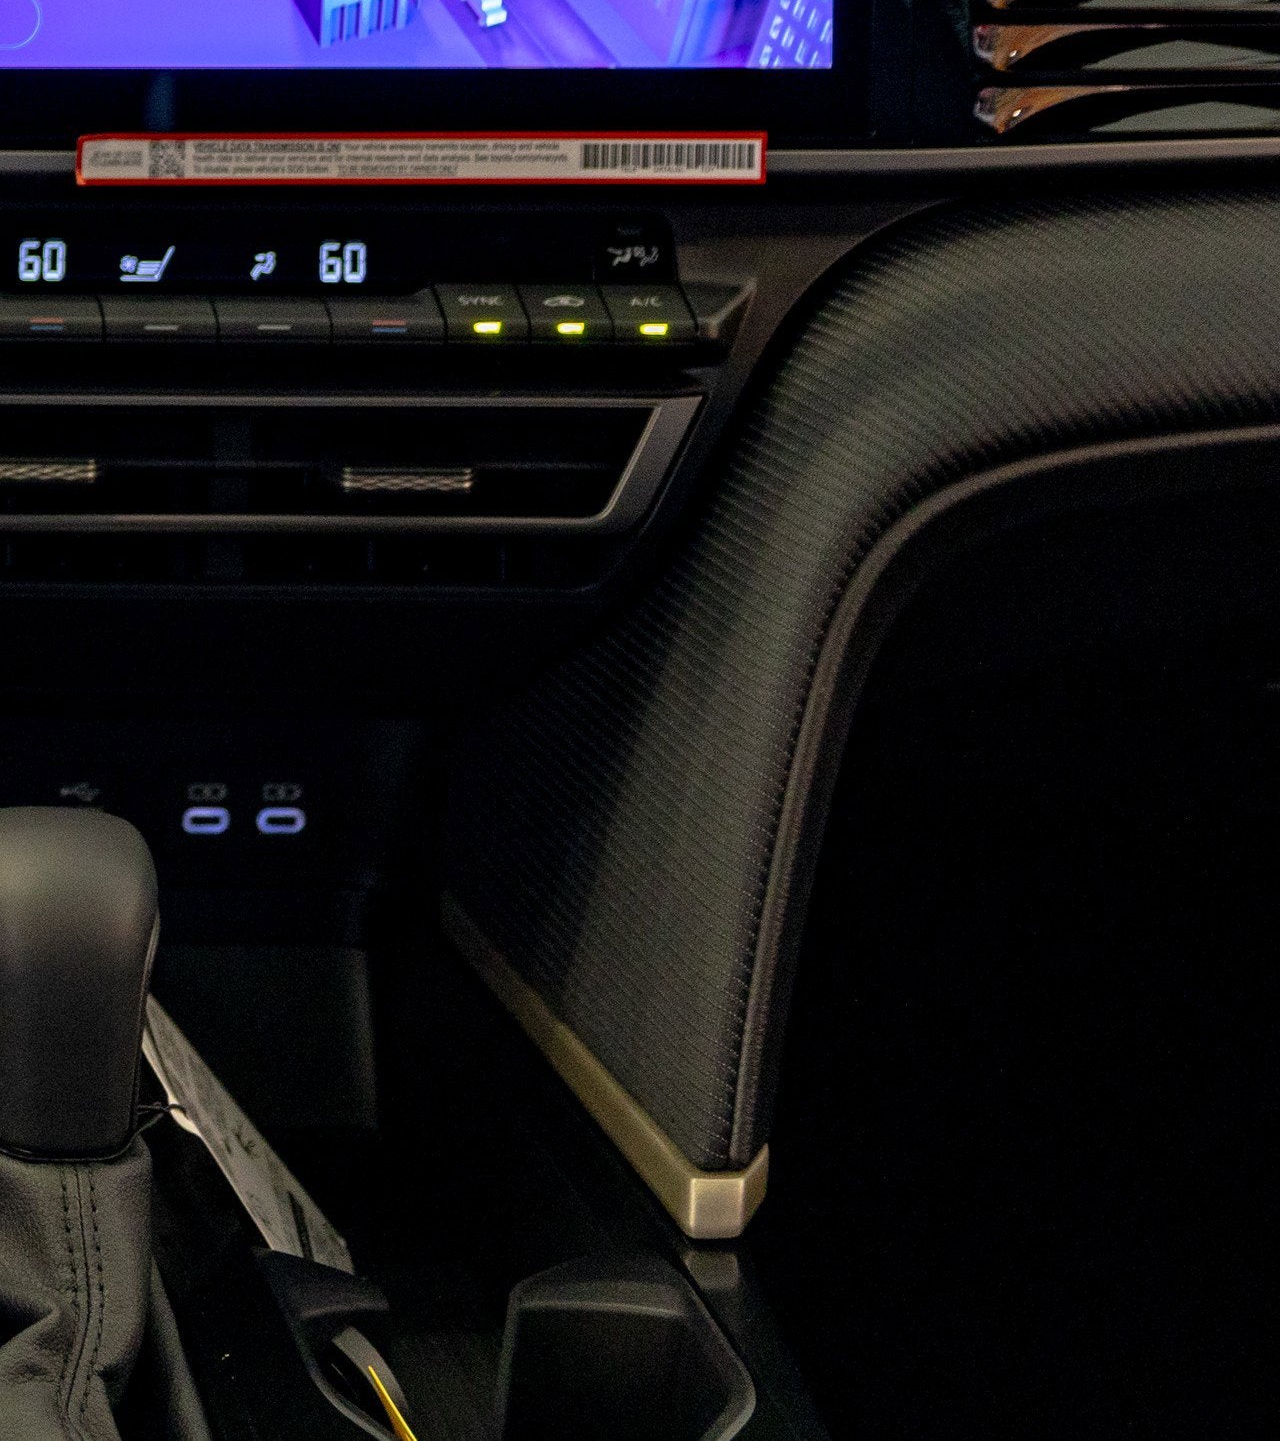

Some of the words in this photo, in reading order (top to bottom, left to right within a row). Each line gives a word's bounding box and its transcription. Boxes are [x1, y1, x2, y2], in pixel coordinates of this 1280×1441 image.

[17, 240, 67, 282] 60
[318, 241, 368, 283] 60
[630, 296, 663, 308] A/C
